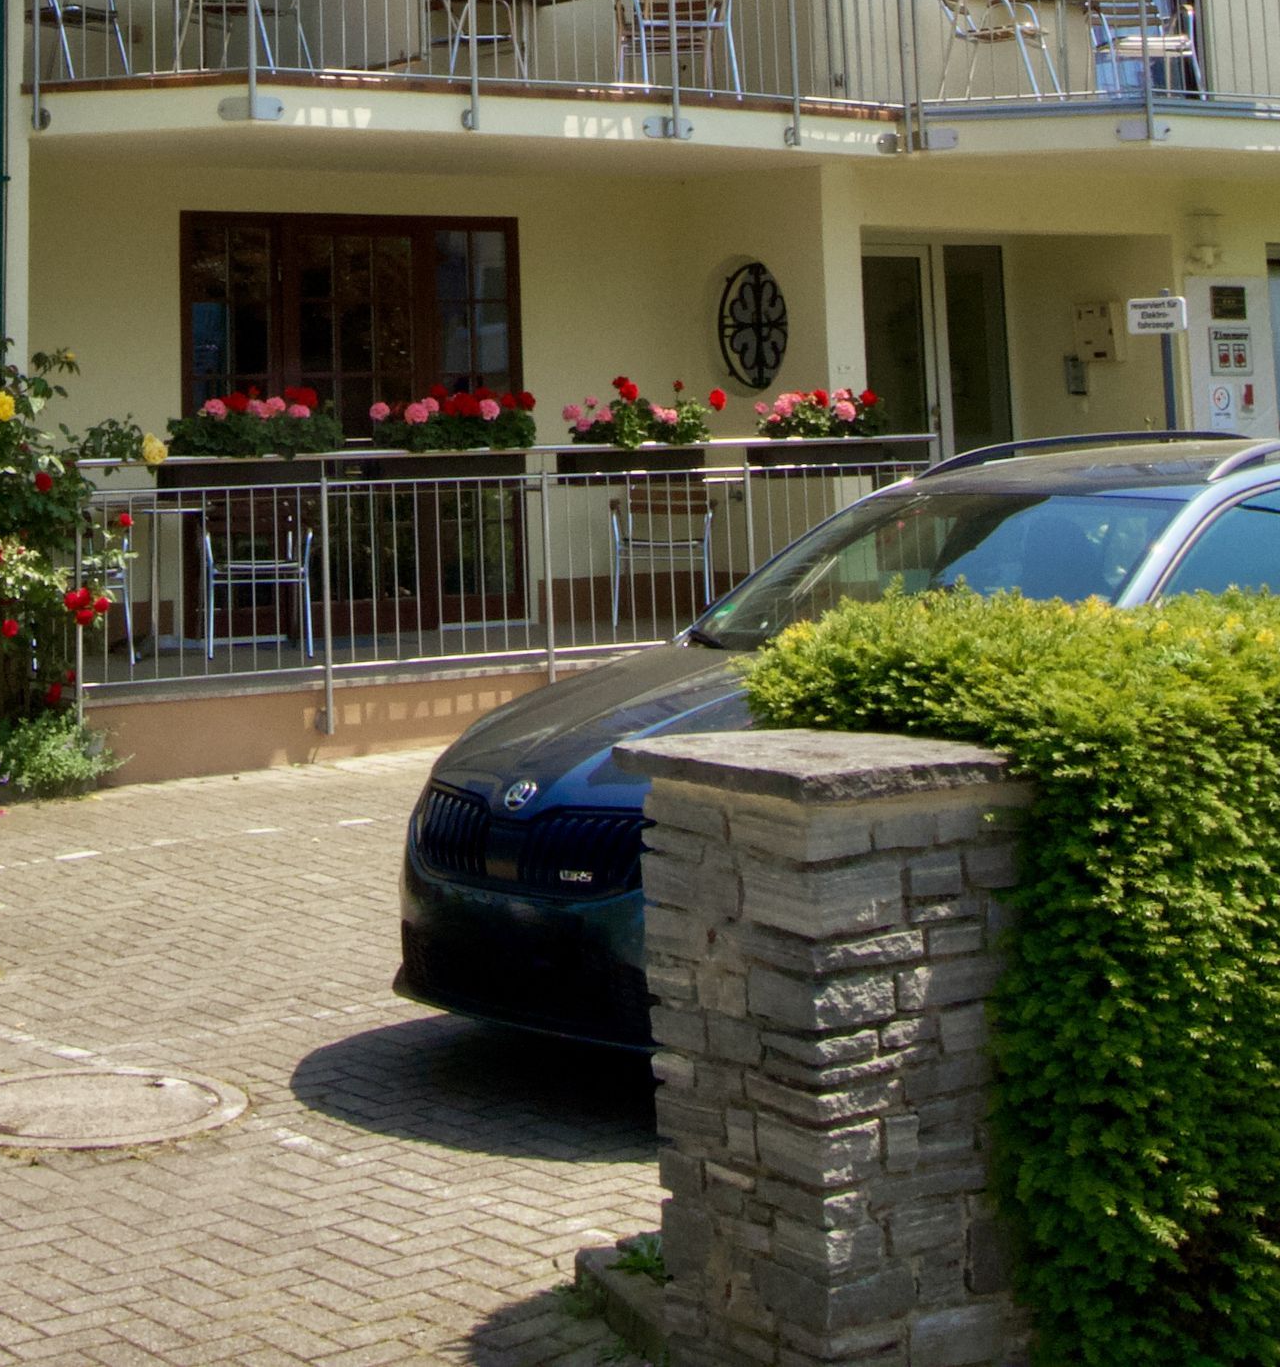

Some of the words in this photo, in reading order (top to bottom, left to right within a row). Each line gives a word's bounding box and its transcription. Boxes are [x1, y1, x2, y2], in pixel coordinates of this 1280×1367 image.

[1130, 301, 1166, 310] reserviert
[1167, 299, 1178, 309] für
[1213, 330, 1249, 341] Zimmer
